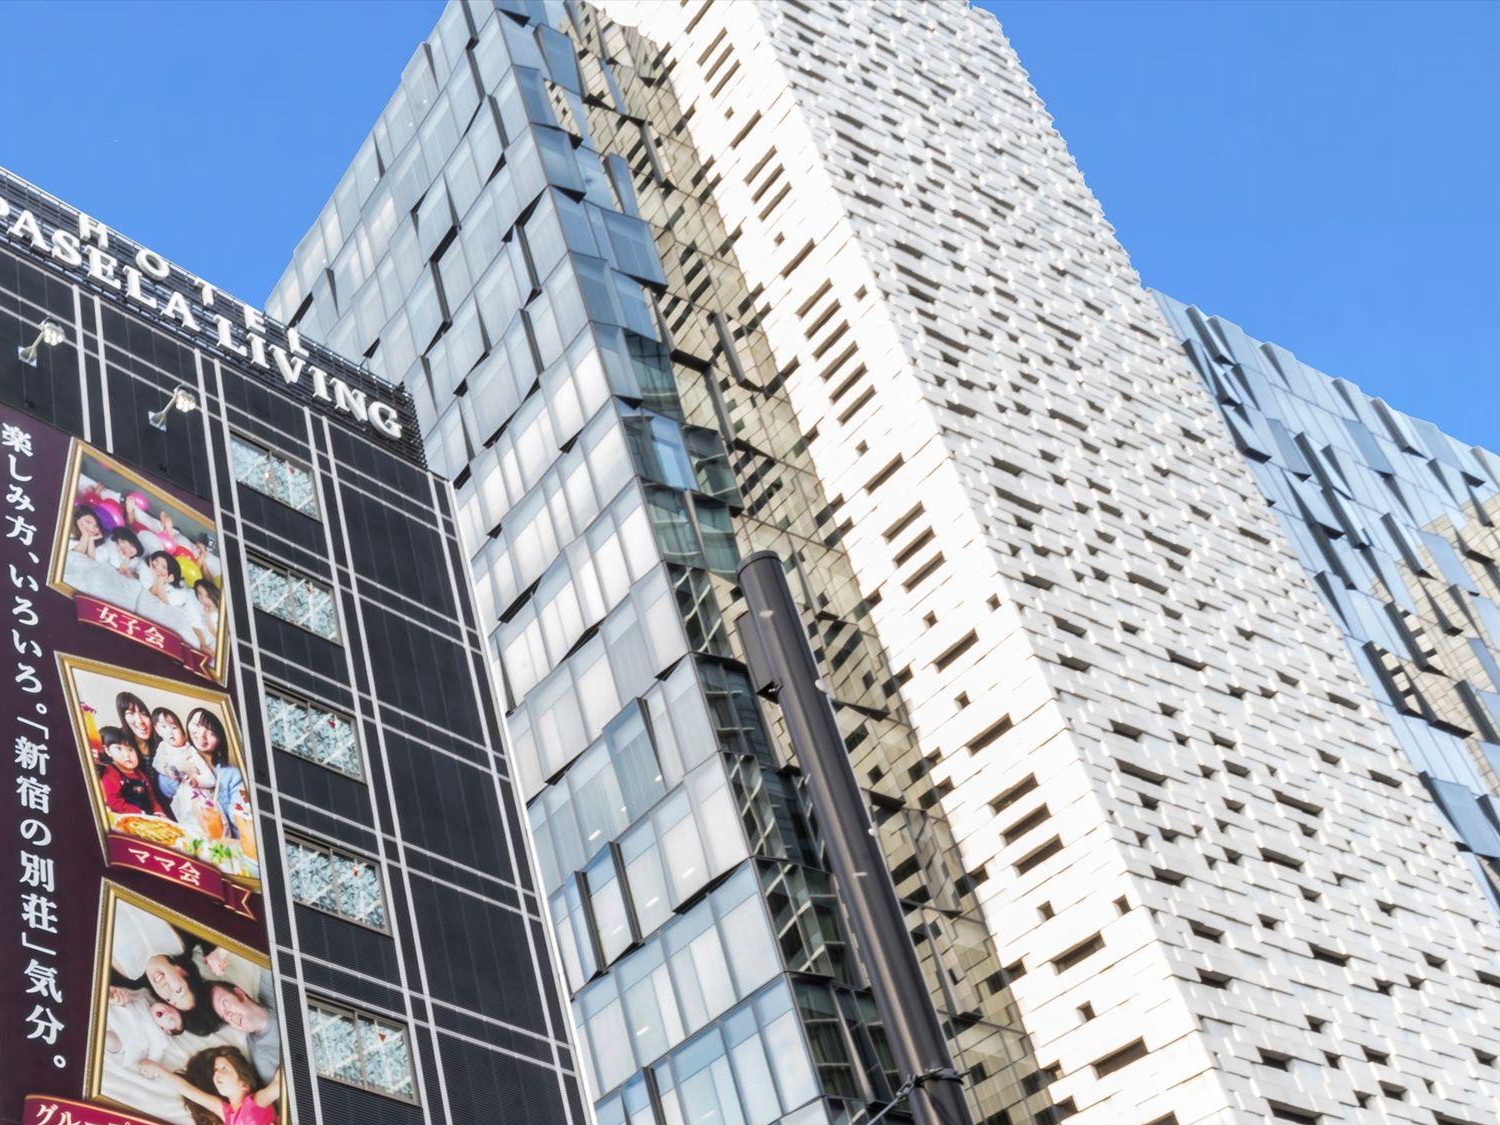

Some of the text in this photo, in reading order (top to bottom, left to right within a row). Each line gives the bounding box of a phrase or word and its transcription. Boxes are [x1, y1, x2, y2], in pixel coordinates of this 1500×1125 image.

[79, 211, 310, 358] HOTEL
[212, 313, 404, 440] LIVING
[95, 606, 166, 650] 女子会
[0, 421, 68, 1071] 楽しみ方、いろいろ。「新宿の別荘」気分。
[126, 846, 202, 888] ママ会
